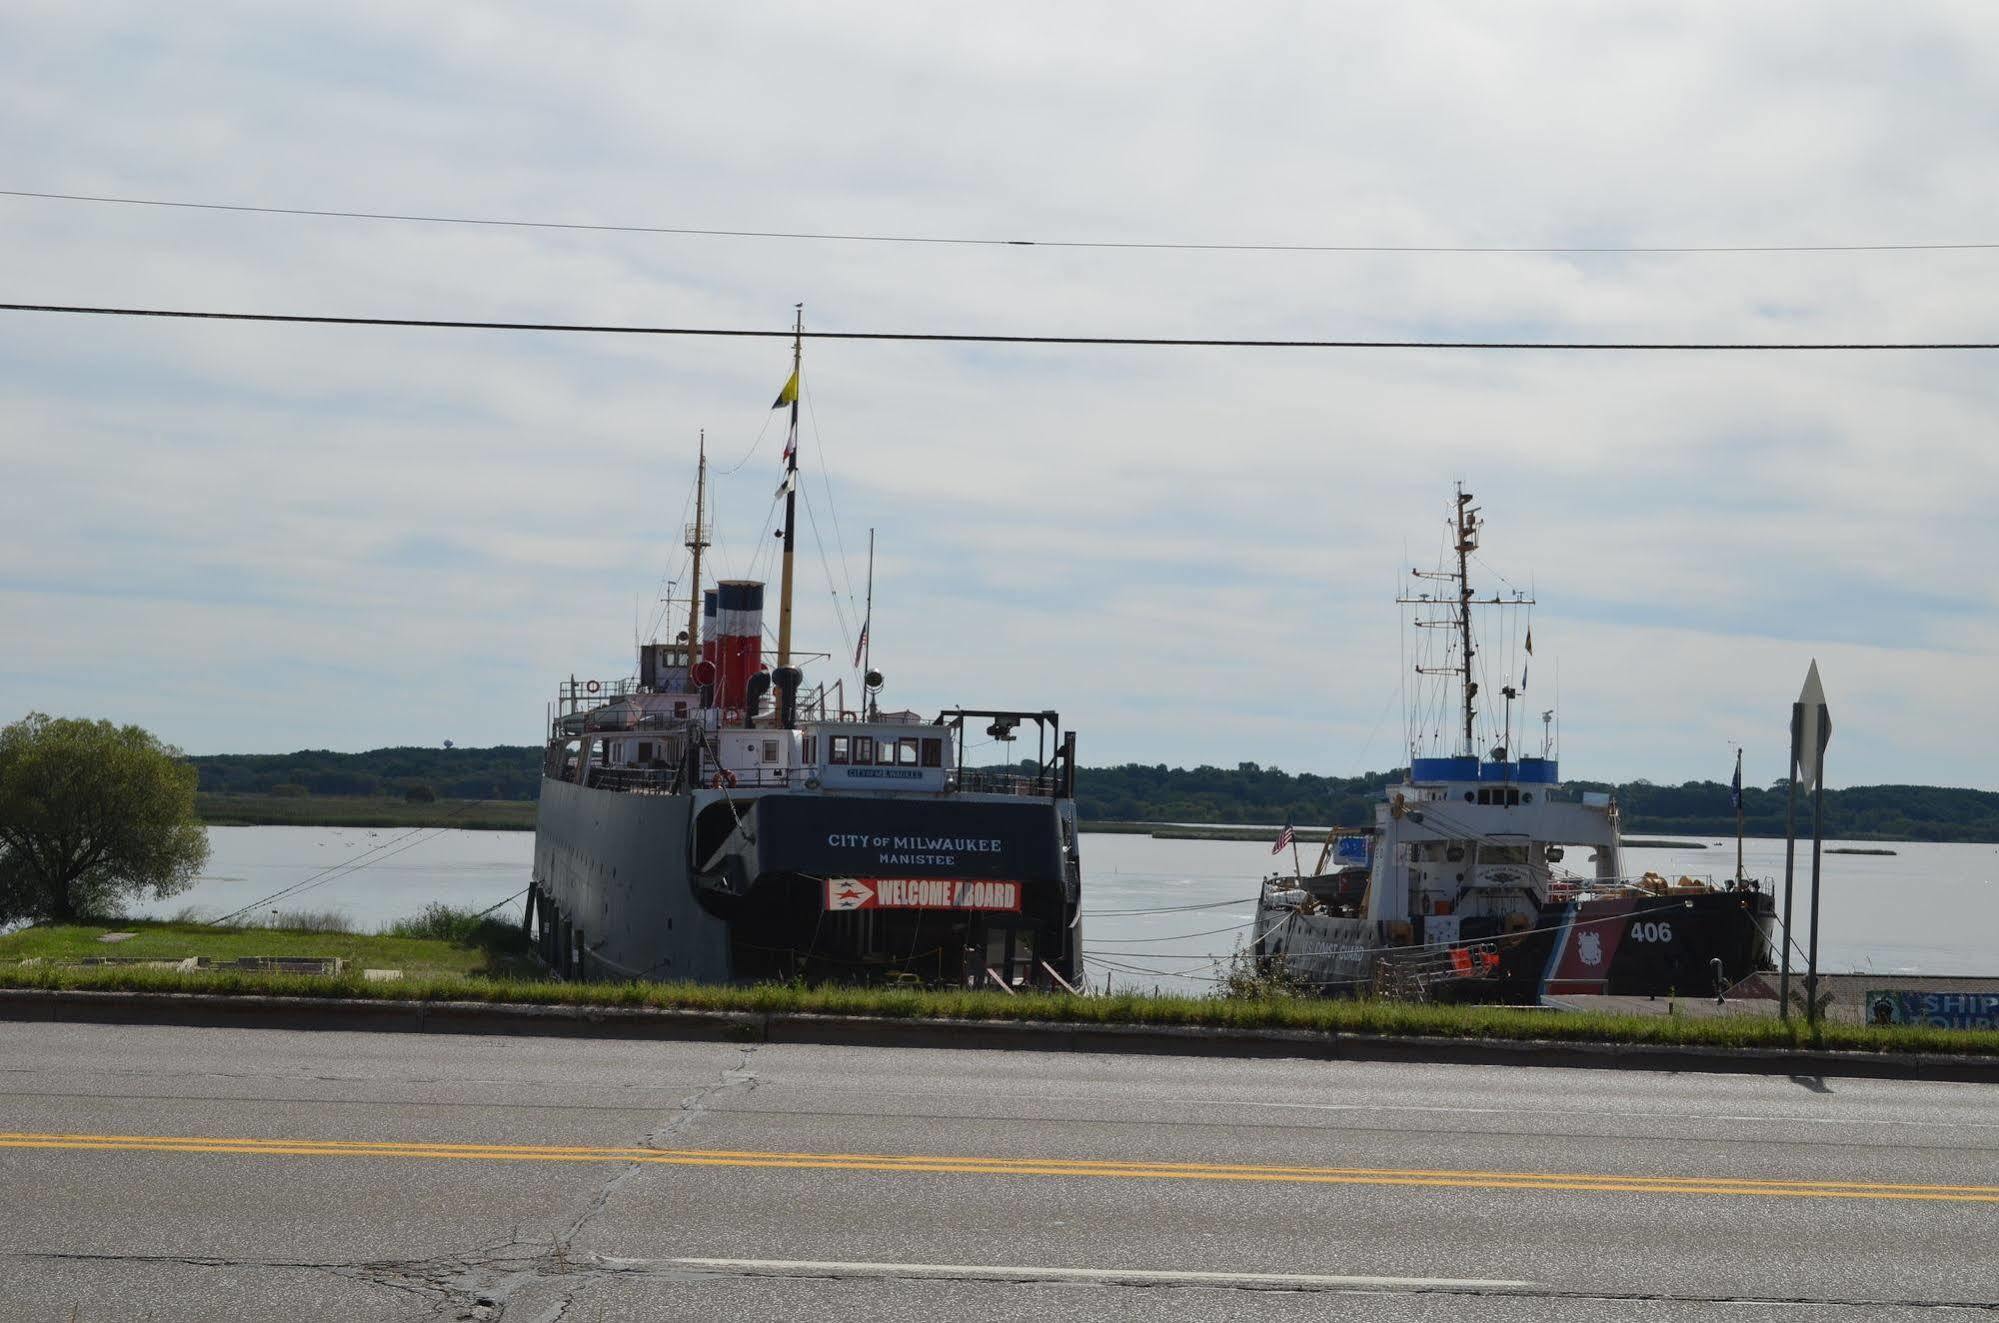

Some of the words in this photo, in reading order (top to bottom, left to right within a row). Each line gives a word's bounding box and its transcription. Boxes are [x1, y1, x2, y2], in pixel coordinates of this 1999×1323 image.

[828, 834, 869, 848] CITY
[873, 837, 890, 847] OF
[894, 837, 1001, 852] MILWAUKEE
[880, 854, 955, 865] MANISTEE
[877, 880, 951, 906] WELCOME
[953, 881, 1015, 908] ABOARD
[1631, 922, 1672, 942] 406
